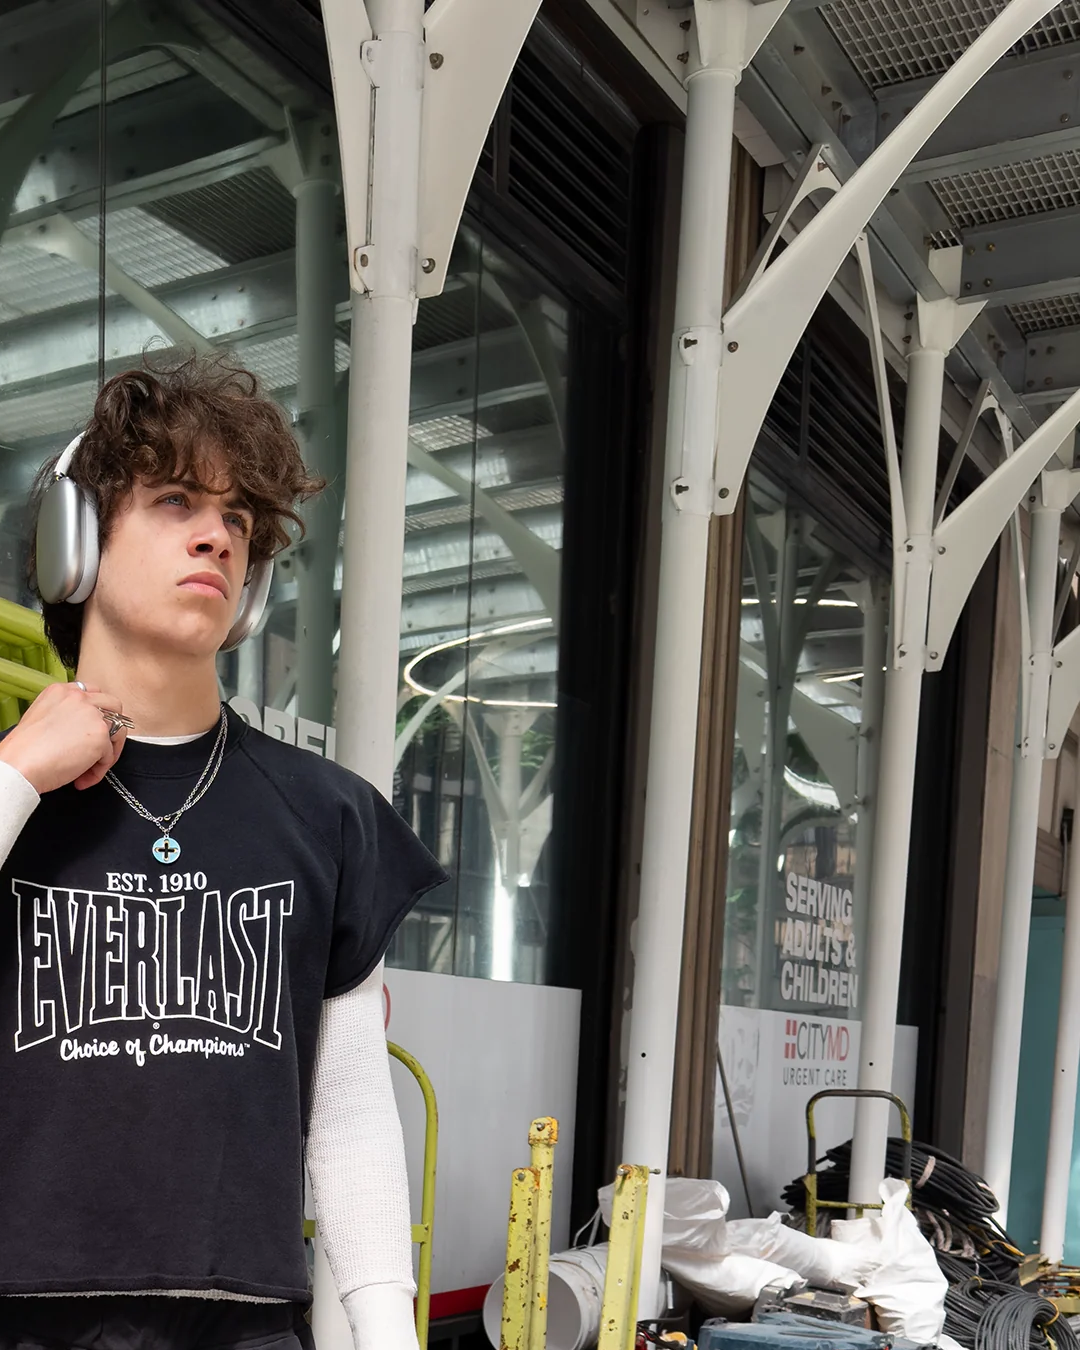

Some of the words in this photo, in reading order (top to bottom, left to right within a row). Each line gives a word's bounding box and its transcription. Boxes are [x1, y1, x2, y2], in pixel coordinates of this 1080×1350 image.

[106, 872, 153, 893] EST.
[159, 871, 207, 893] 1910
[785, 872, 853, 926] SERVING
[783, 917, 842, 966] ADULTS
[845, 932, 856, 968] &
[12, 878, 294, 1052] EVERLAST
[781, 961, 858, 1008] CHILDREN
[60, 1038, 120, 1061] Choice
[125, 1038, 146, 1067] of
[796, 1022, 850, 1061] CITYMD
[783, 1067, 820, 1085] URGENT
[824, 1069, 847, 1086] CARE
